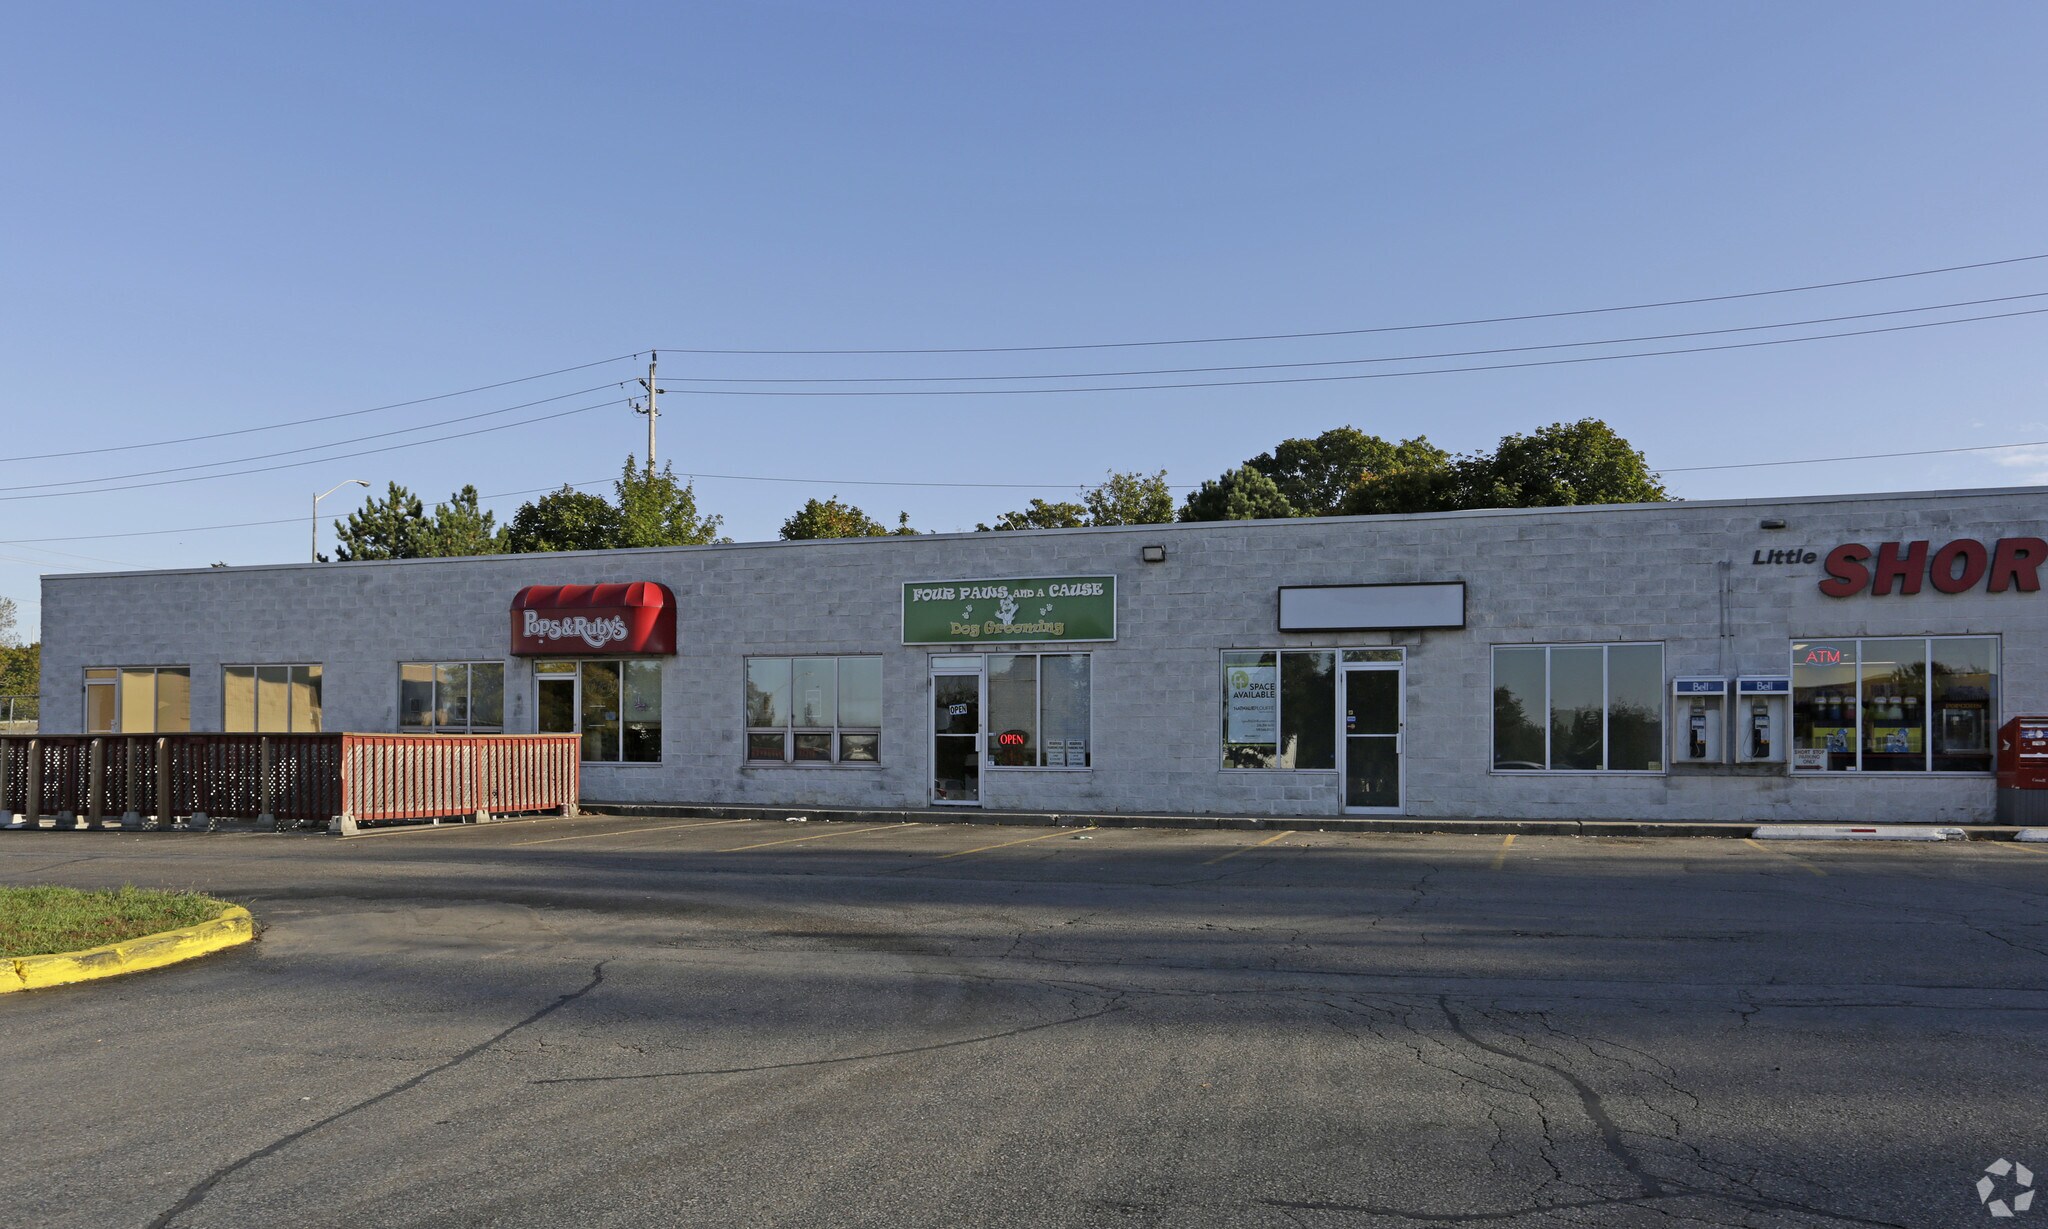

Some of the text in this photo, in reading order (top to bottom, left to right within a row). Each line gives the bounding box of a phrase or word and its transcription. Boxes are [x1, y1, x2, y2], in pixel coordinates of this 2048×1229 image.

[1818, 537, 2048, 598] SHOR
[913, 582, 1104, 602] FOUR PAWS AND A CAUSE
[950, 619, 1065, 638] Dog Grooming
[1805, 650, 1840, 664] ATM
[1250, 683, 1275, 691] SPACE
[1693, 682, 1709, 691] Bell
[1756, 681, 1773, 691] Bell
[1233, 691, 1275, 699] AVAILABLE
[950, 705, 966, 714] OPEN
[1000, 734, 1024, 745] OPEN
